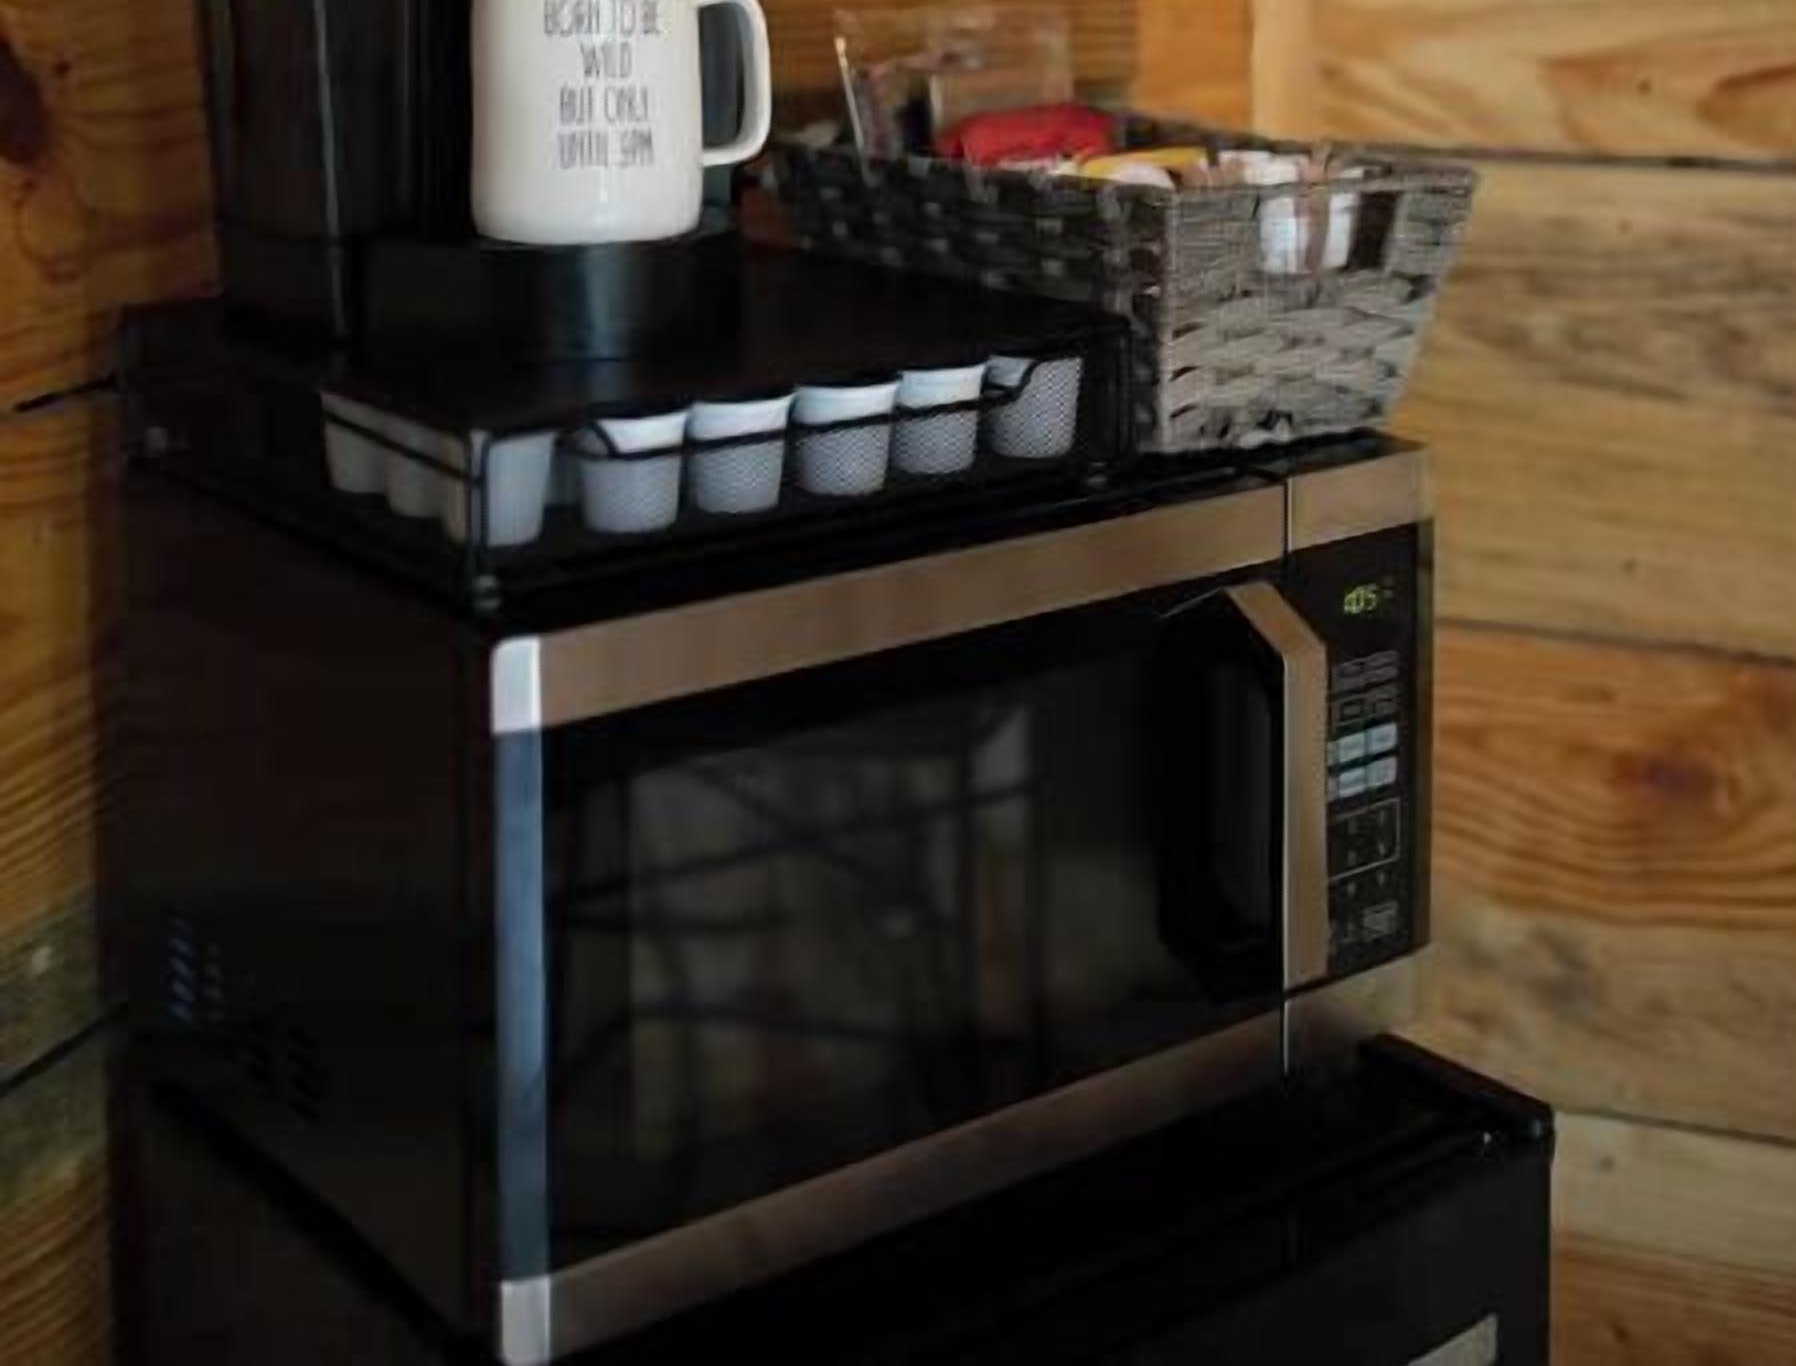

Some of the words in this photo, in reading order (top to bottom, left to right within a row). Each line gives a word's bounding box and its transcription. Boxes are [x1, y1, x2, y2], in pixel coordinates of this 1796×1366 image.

[580, 42, 632, 78] WILD
[560, 85, 593, 124] BUT
[605, 85, 648, 123] ONLY
[557, 131, 608, 169] UNTIL
